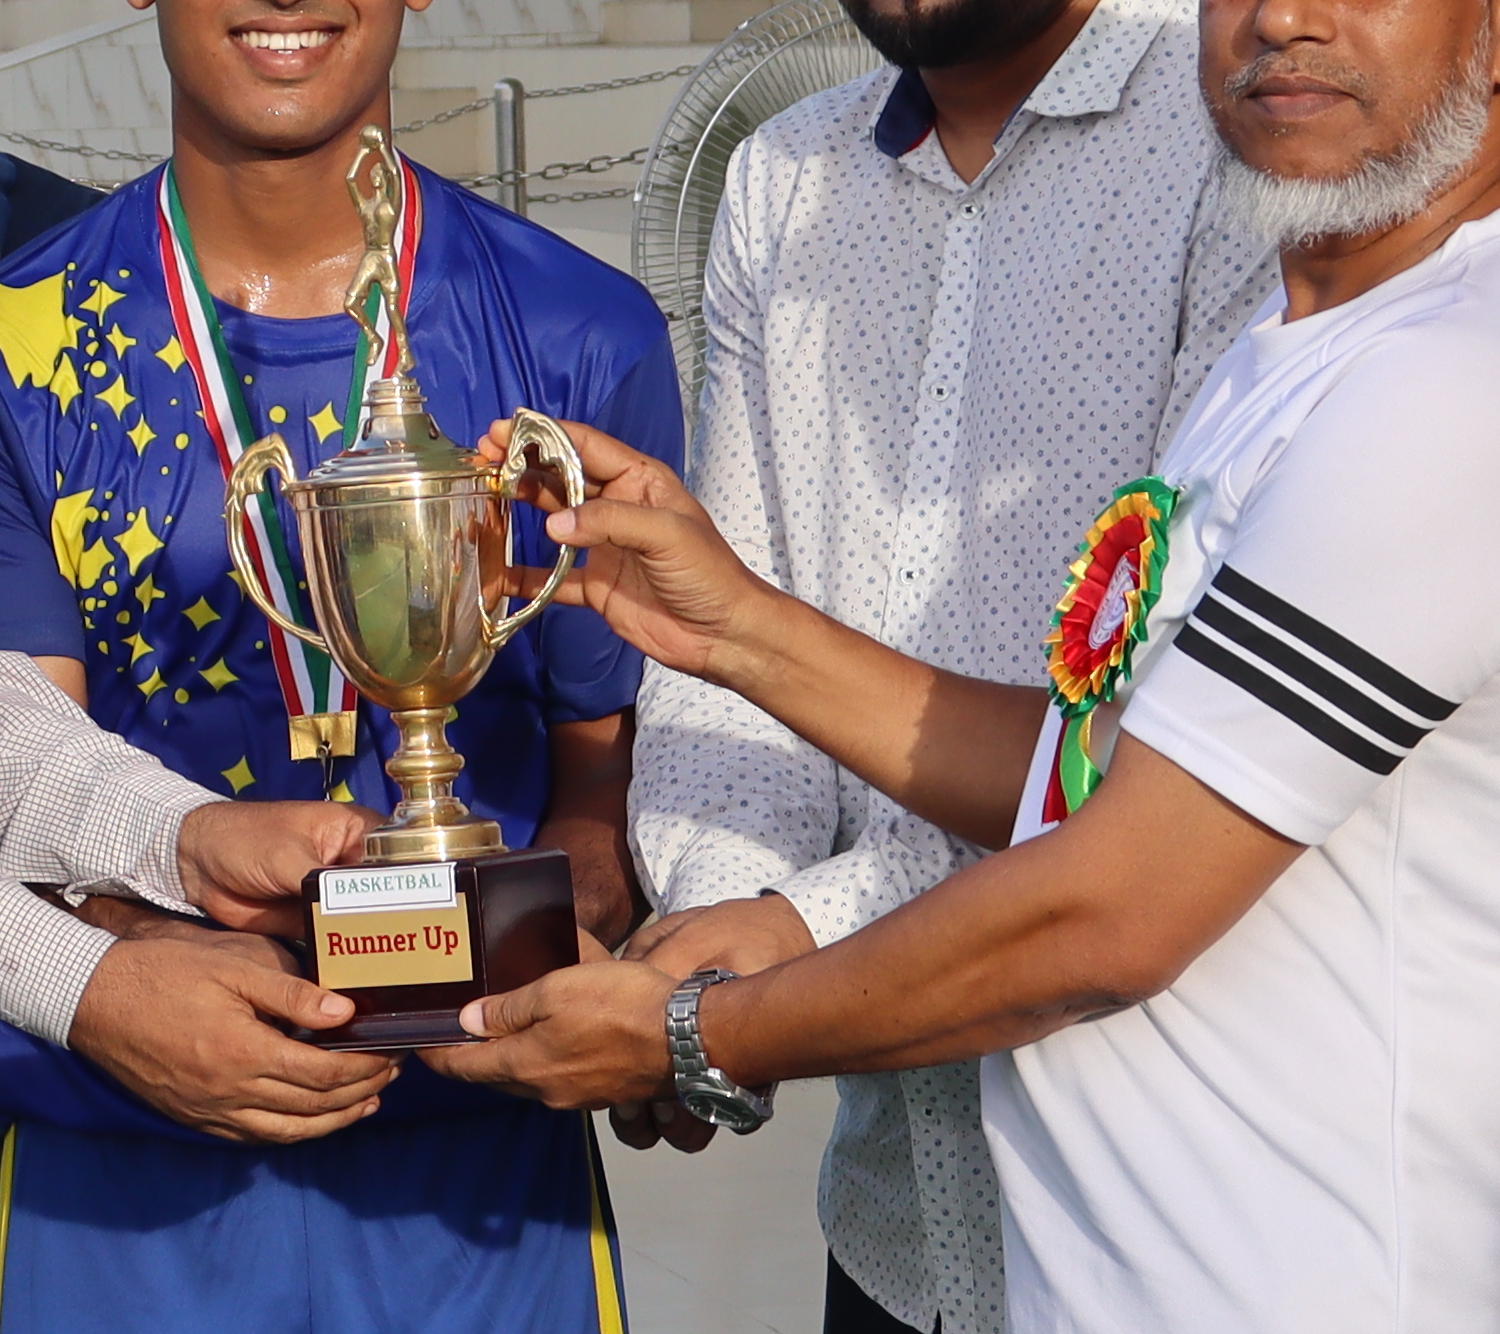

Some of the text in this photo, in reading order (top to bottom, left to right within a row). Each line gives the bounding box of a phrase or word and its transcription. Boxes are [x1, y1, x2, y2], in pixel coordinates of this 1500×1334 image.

[335, 873, 442, 895] BASKETBAL
[327, 925, 459, 956] Runner Up
